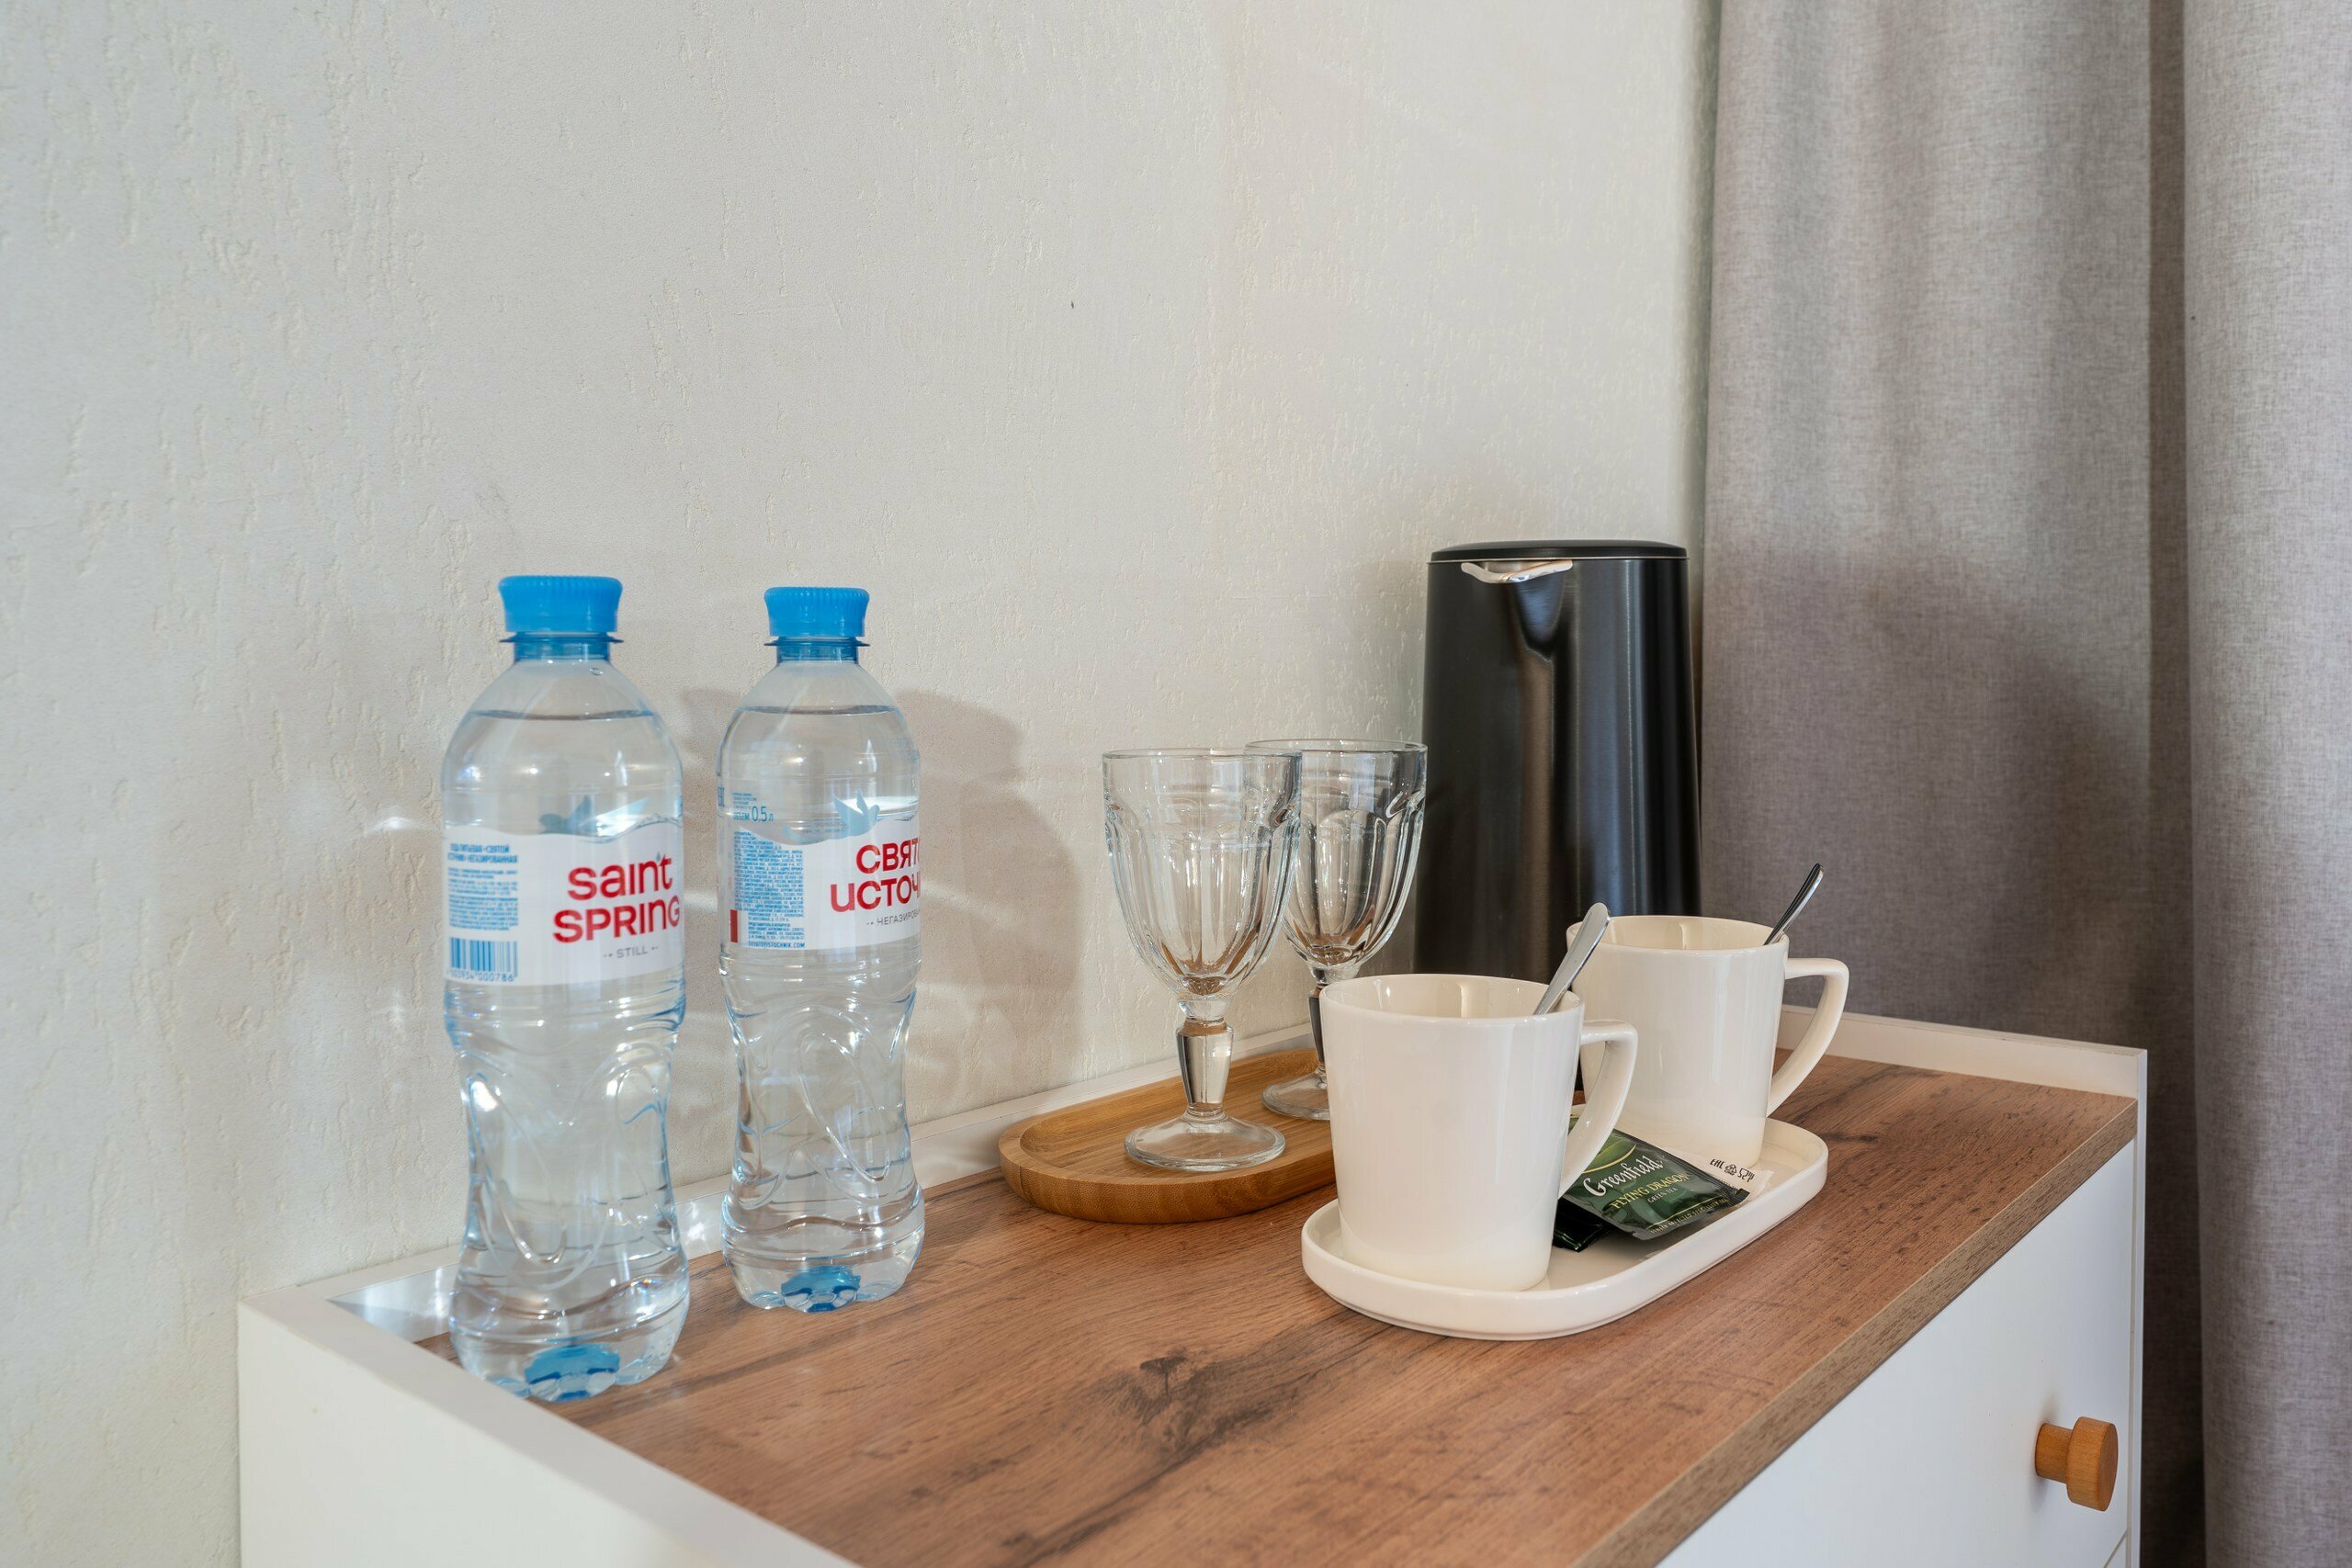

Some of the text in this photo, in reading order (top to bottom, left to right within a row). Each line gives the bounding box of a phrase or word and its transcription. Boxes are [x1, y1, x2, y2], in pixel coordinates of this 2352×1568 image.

[856, 837, 920, 874] СВЯТ
[567, 853, 673, 901] saint
[553, 895, 680, 943] SPRING
[876, 908, 920, 926] НЕГАЗИРОВ
[616, 946, 648, 958] STILL
[1583, 1155, 1664, 1197] Greenfield
[1610, 1186, 1650, 1210] FLYING
[1647, 1172, 1690, 1193] DRAGON
[1647, 1190, 1668, 1203] GREEN
